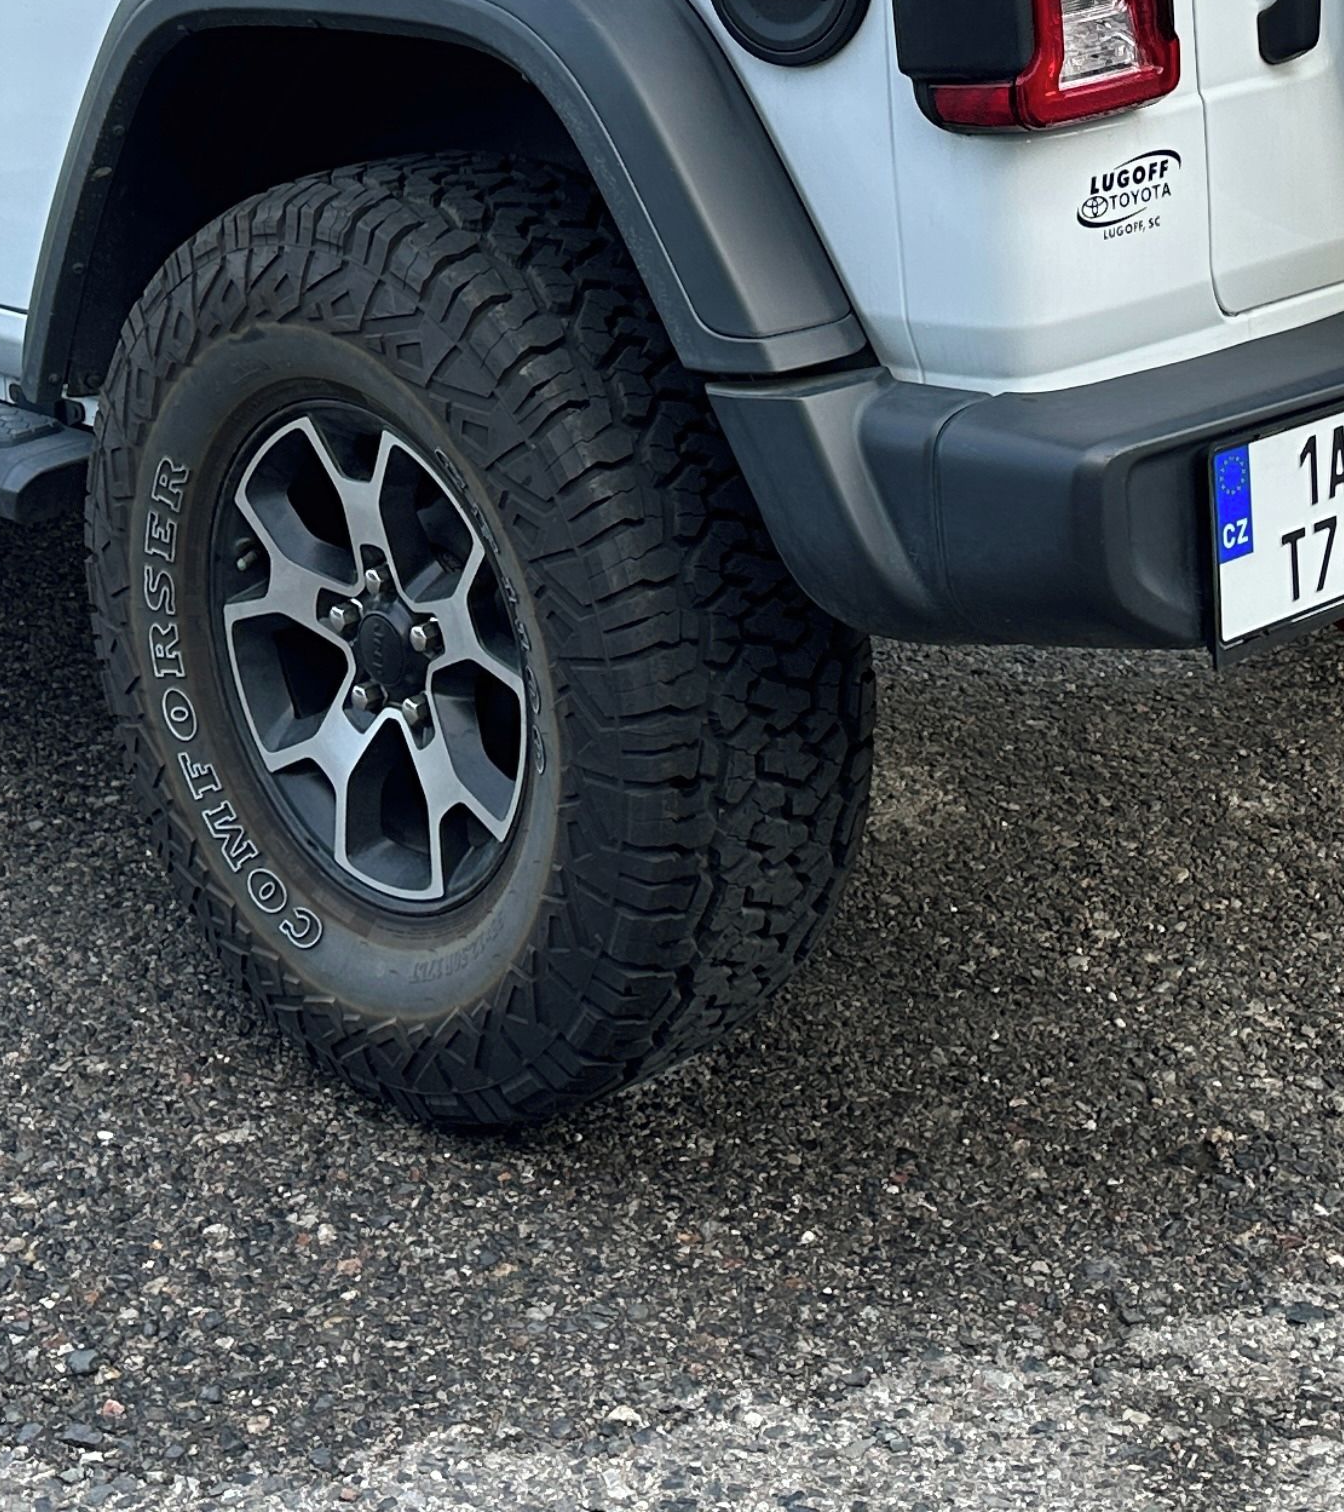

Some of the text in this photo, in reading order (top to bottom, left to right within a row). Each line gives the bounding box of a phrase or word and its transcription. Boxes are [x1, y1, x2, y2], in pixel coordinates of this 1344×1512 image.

[1090, 159, 1169, 195] LUGOFF
[1109, 182, 1172, 210] TOYOTA
[1103, 216, 1161, 240] LUGOFF, SC
[1222, 518, 1249, 549] CZ
[144, 456, 323, 950] COMFORSER
